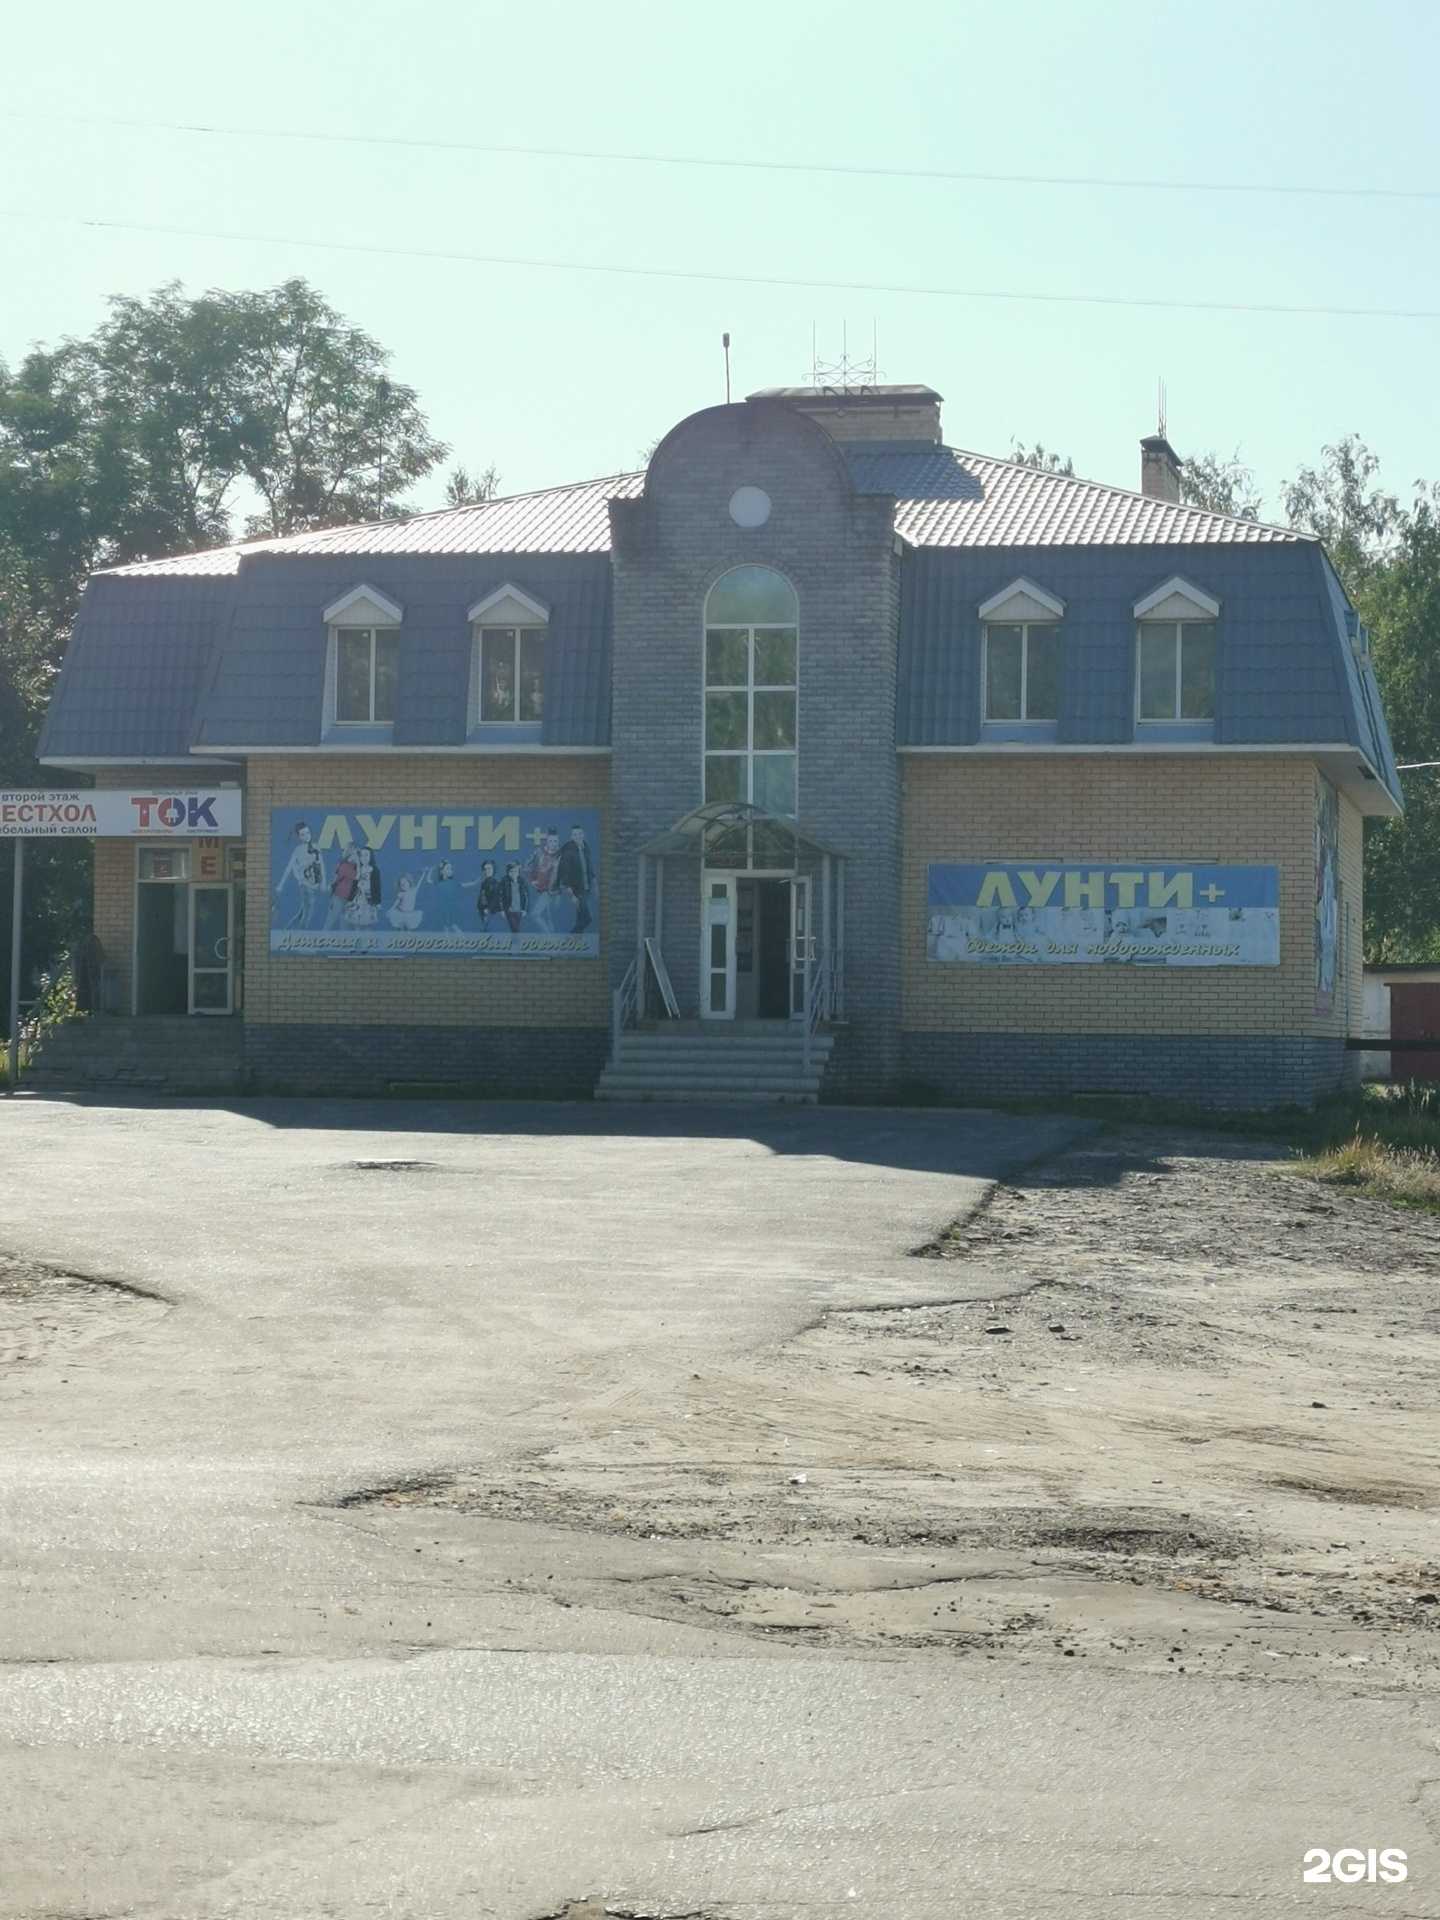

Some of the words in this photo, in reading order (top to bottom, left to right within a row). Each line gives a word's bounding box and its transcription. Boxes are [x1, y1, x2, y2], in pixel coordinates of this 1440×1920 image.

[1, 792, 45, 803] второй
[48, 792, 80, 801] этаж
[131, 797, 218, 827] ТОК
[61, 825, 96, 834] салон
